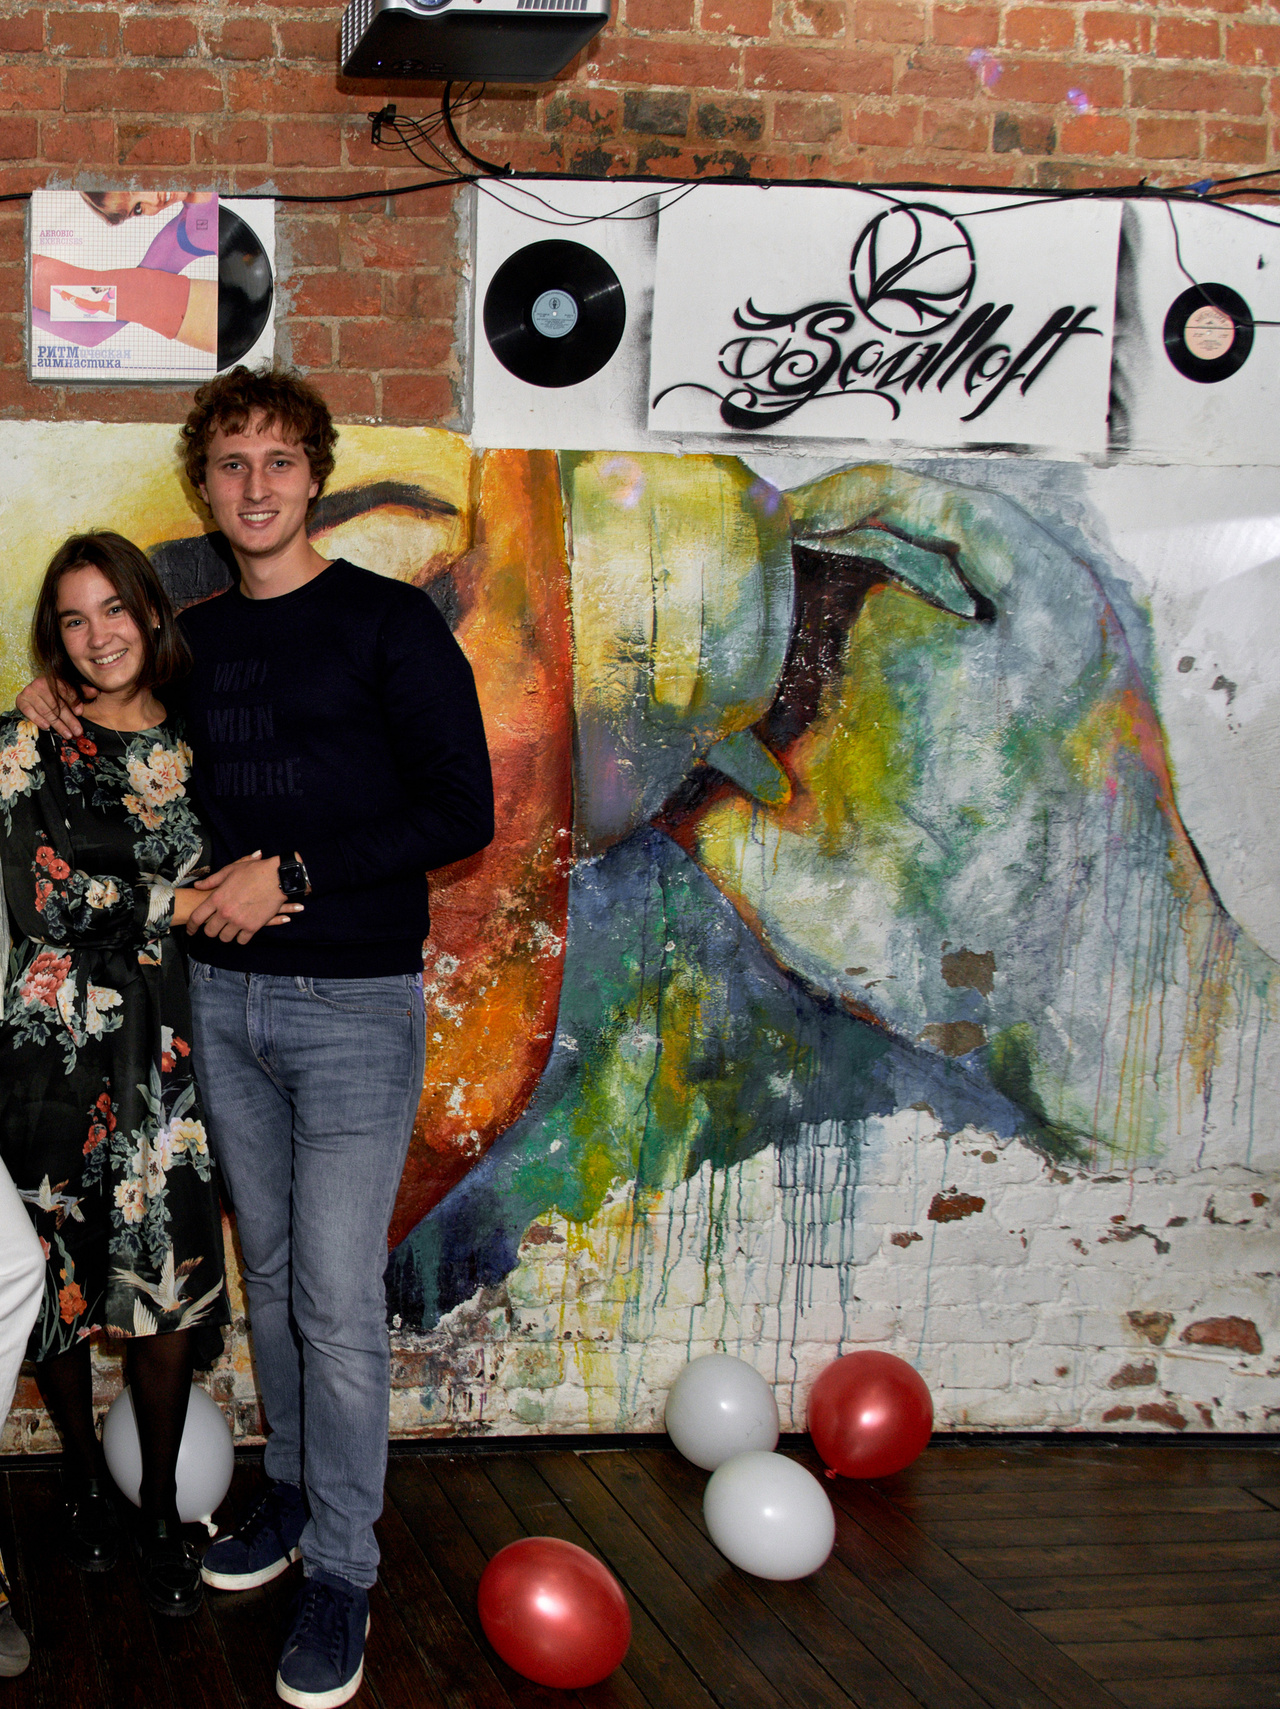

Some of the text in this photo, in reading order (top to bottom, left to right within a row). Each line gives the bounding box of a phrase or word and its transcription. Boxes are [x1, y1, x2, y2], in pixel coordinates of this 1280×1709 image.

[40, 229, 74, 238] AEROBIC
[40, 238, 83, 246] EXERCISES
[37, 358, 122, 368] гимнастика
[213, 757, 304, 797] WHERE
